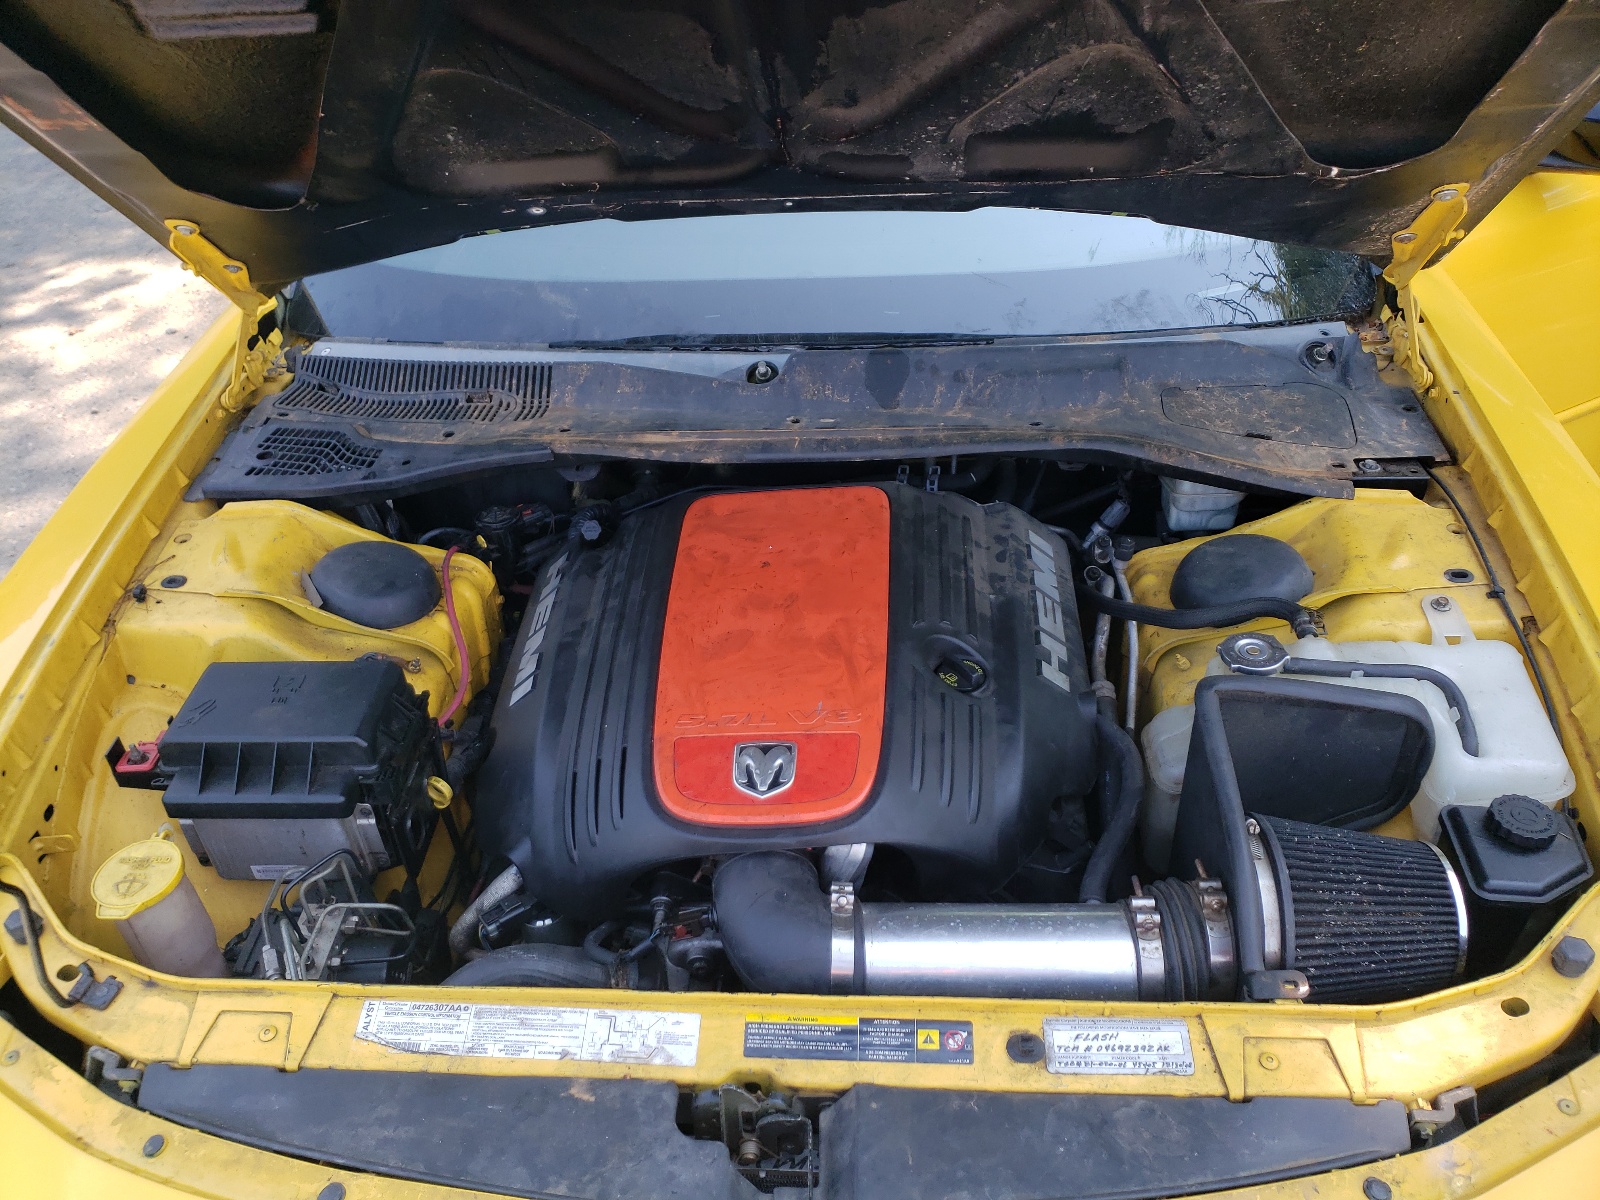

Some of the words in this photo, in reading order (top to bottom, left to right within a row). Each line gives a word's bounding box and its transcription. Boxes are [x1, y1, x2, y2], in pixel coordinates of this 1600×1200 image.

[509, 551, 570, 708] HEMI
[1029, 530, 1070, 692] HEMI
[675, 710, 777, 729] 5.7L
[788, 709, 862, 725] V8
[1073, 1032, 1119, 1042] FLASH
